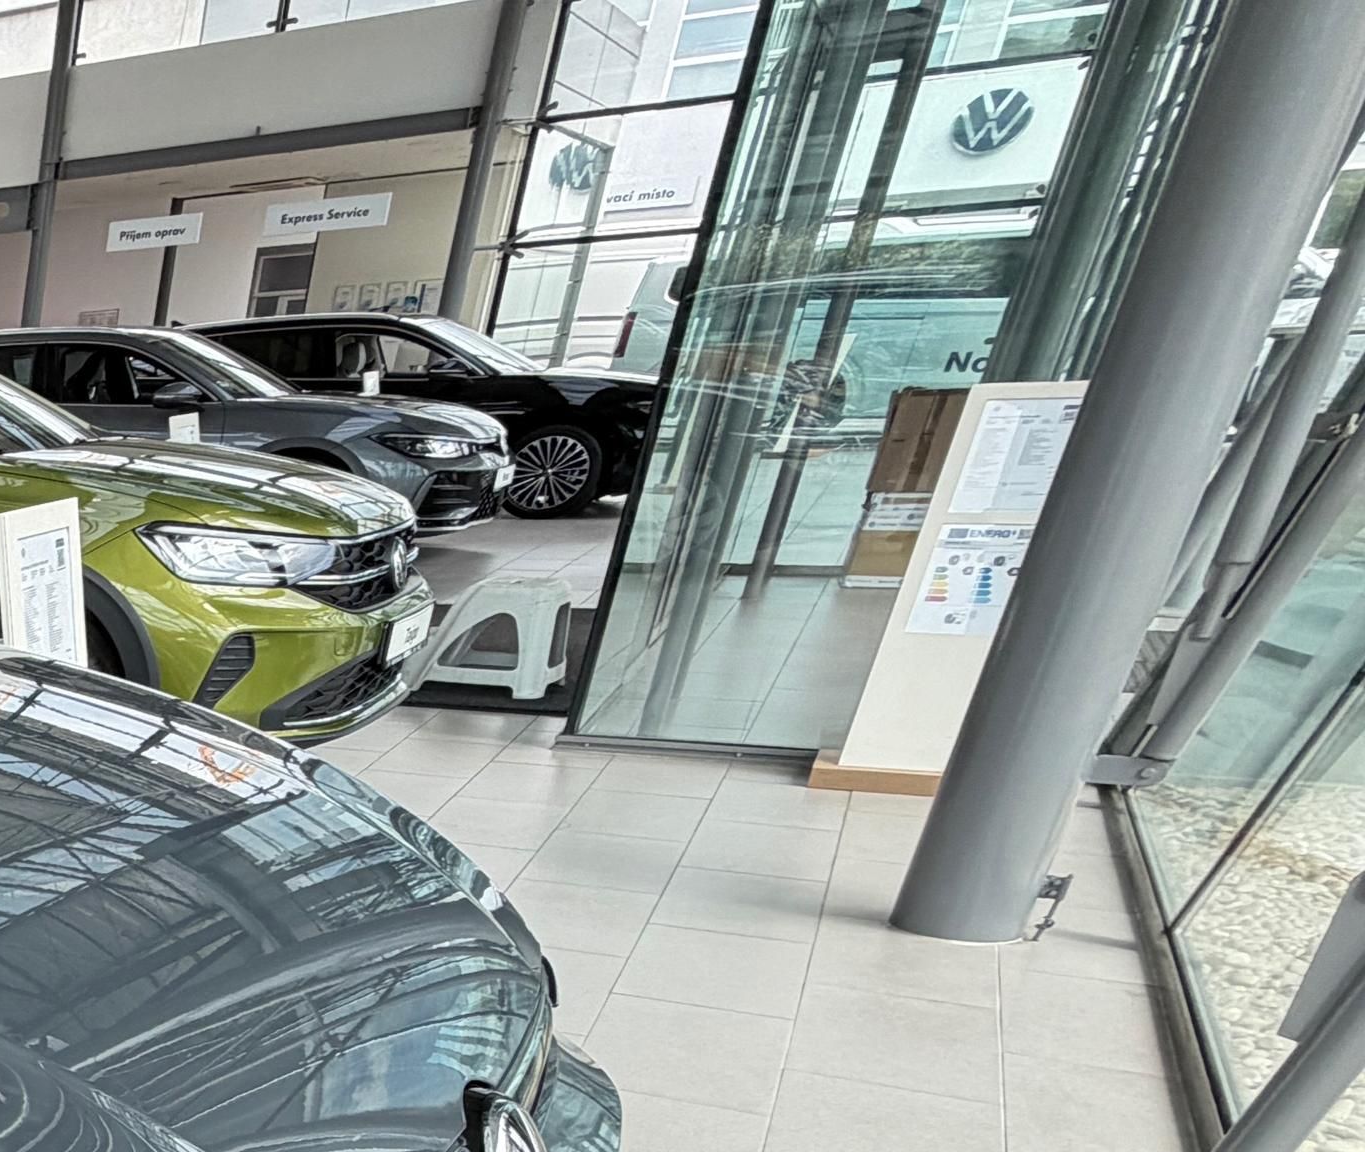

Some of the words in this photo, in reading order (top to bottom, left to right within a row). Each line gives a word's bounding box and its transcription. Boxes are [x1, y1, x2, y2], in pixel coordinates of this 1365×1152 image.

[638, 188, 676, 201] místo
[280, 213, 324, 226] Express
[326, 207, 370, 220] Service
[119, 230, 151, 243] Příjem
[154, 228, 187, 240] oprav
